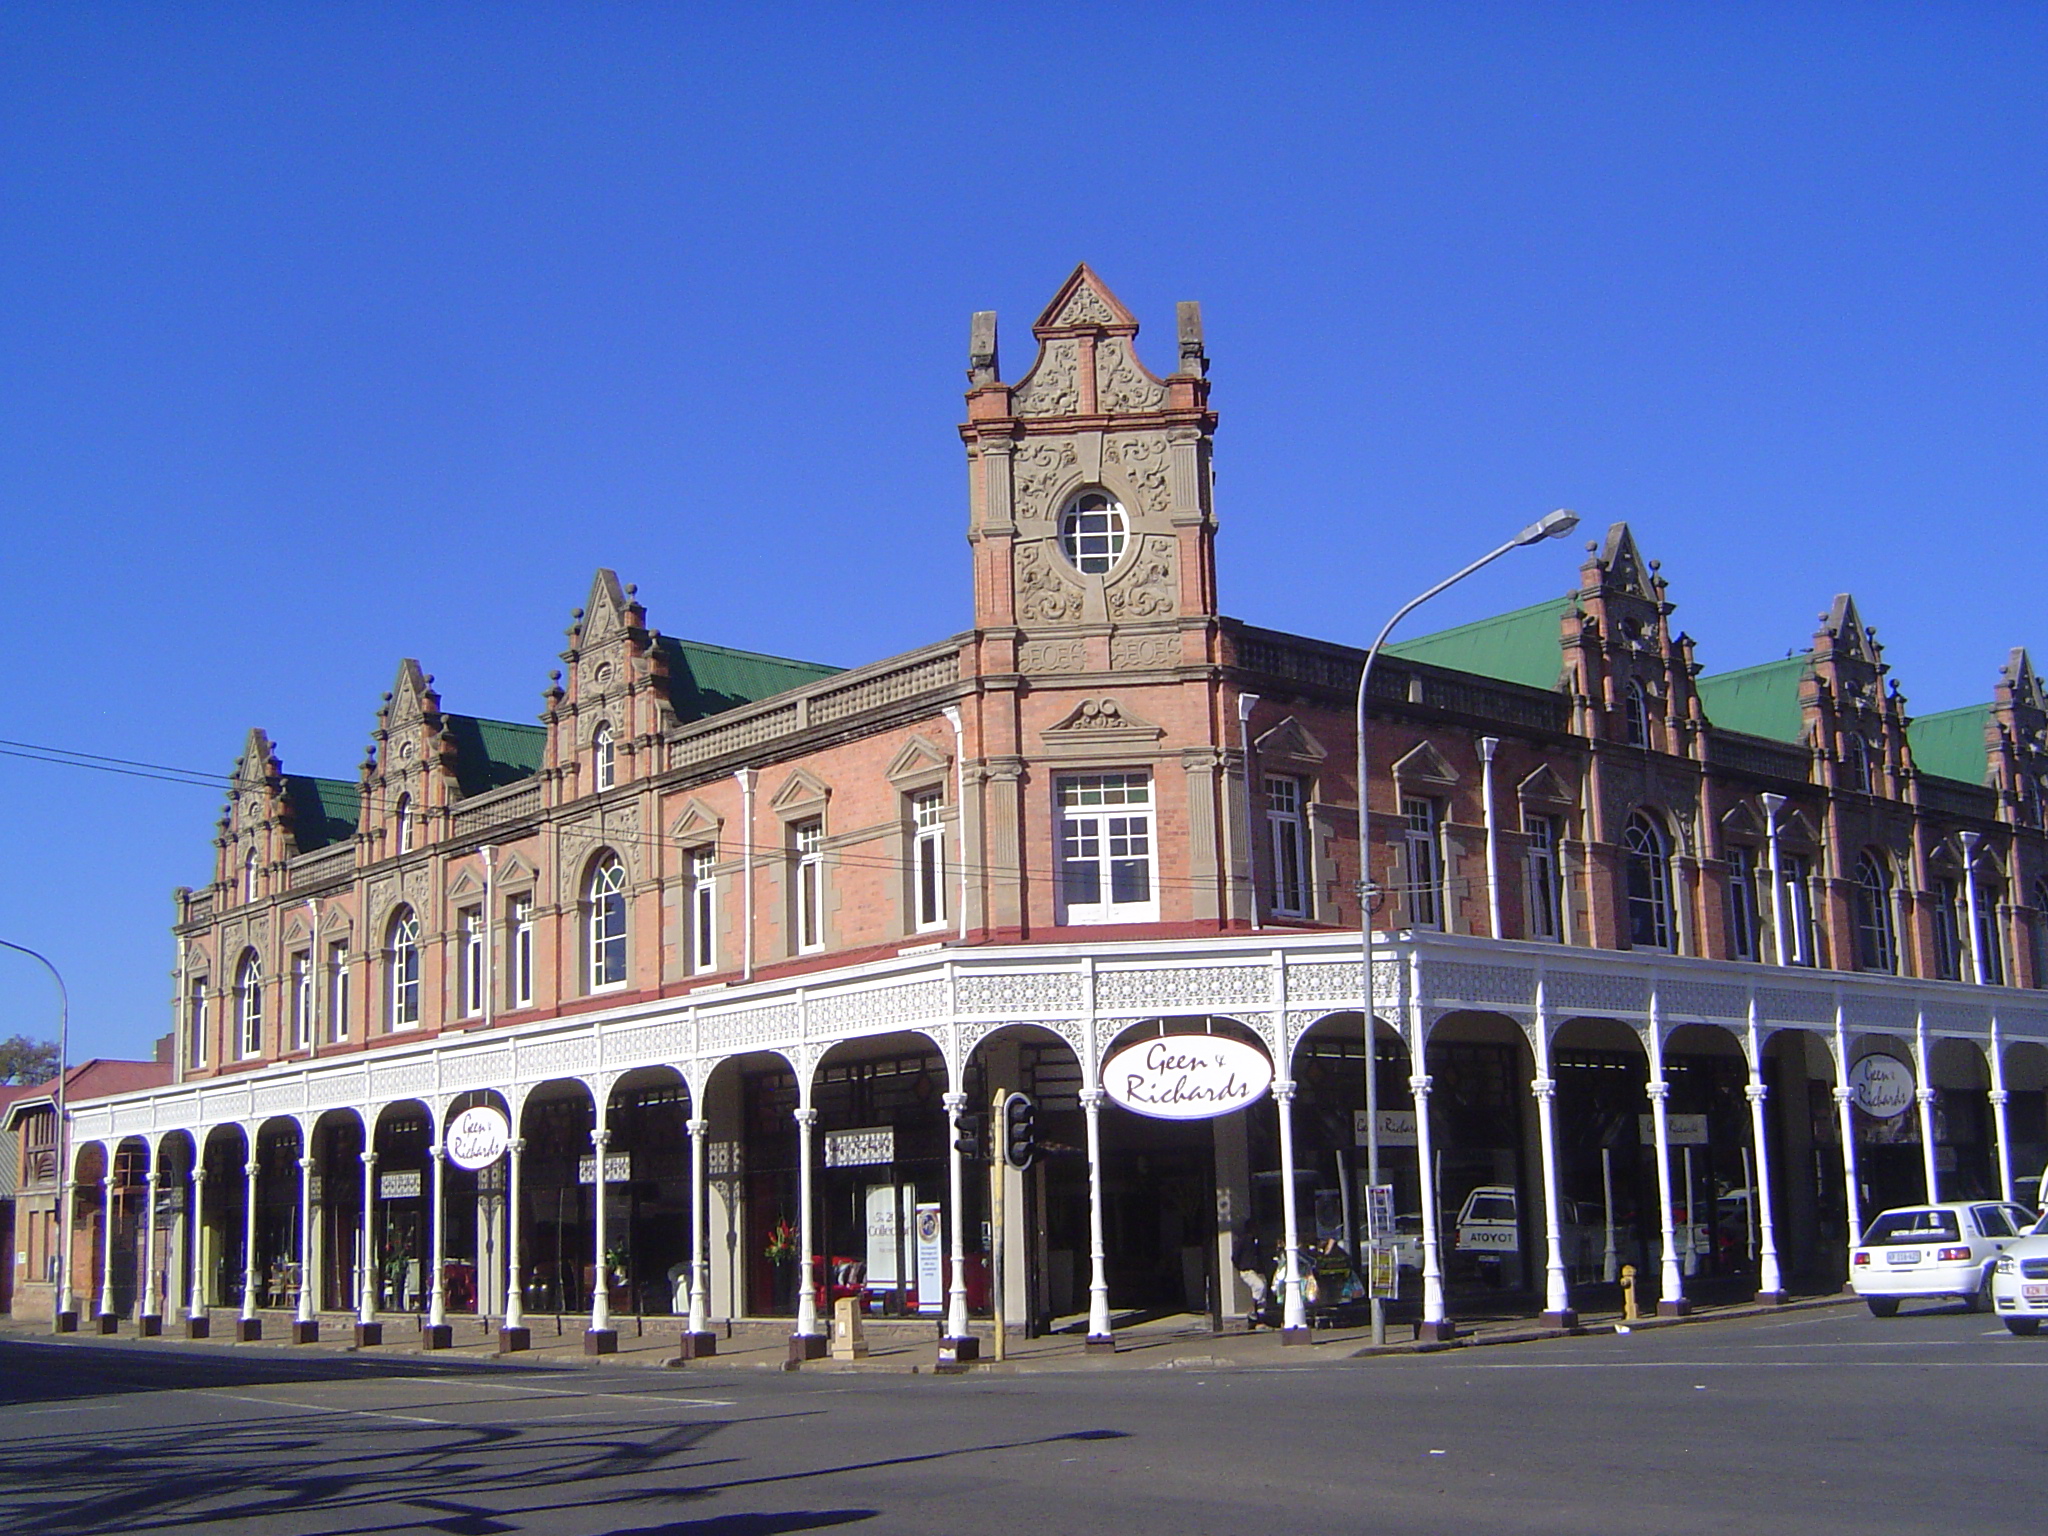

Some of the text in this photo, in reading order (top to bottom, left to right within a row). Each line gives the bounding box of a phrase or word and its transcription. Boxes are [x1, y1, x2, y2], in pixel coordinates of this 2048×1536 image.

[1146, 1043, 1226, 1076] Geen &
[1126, 1072, 1250, 1104] Richards
[1858, 1083, 1906, 1107] Richards
[455, 1136, 500, 1159] Richards
